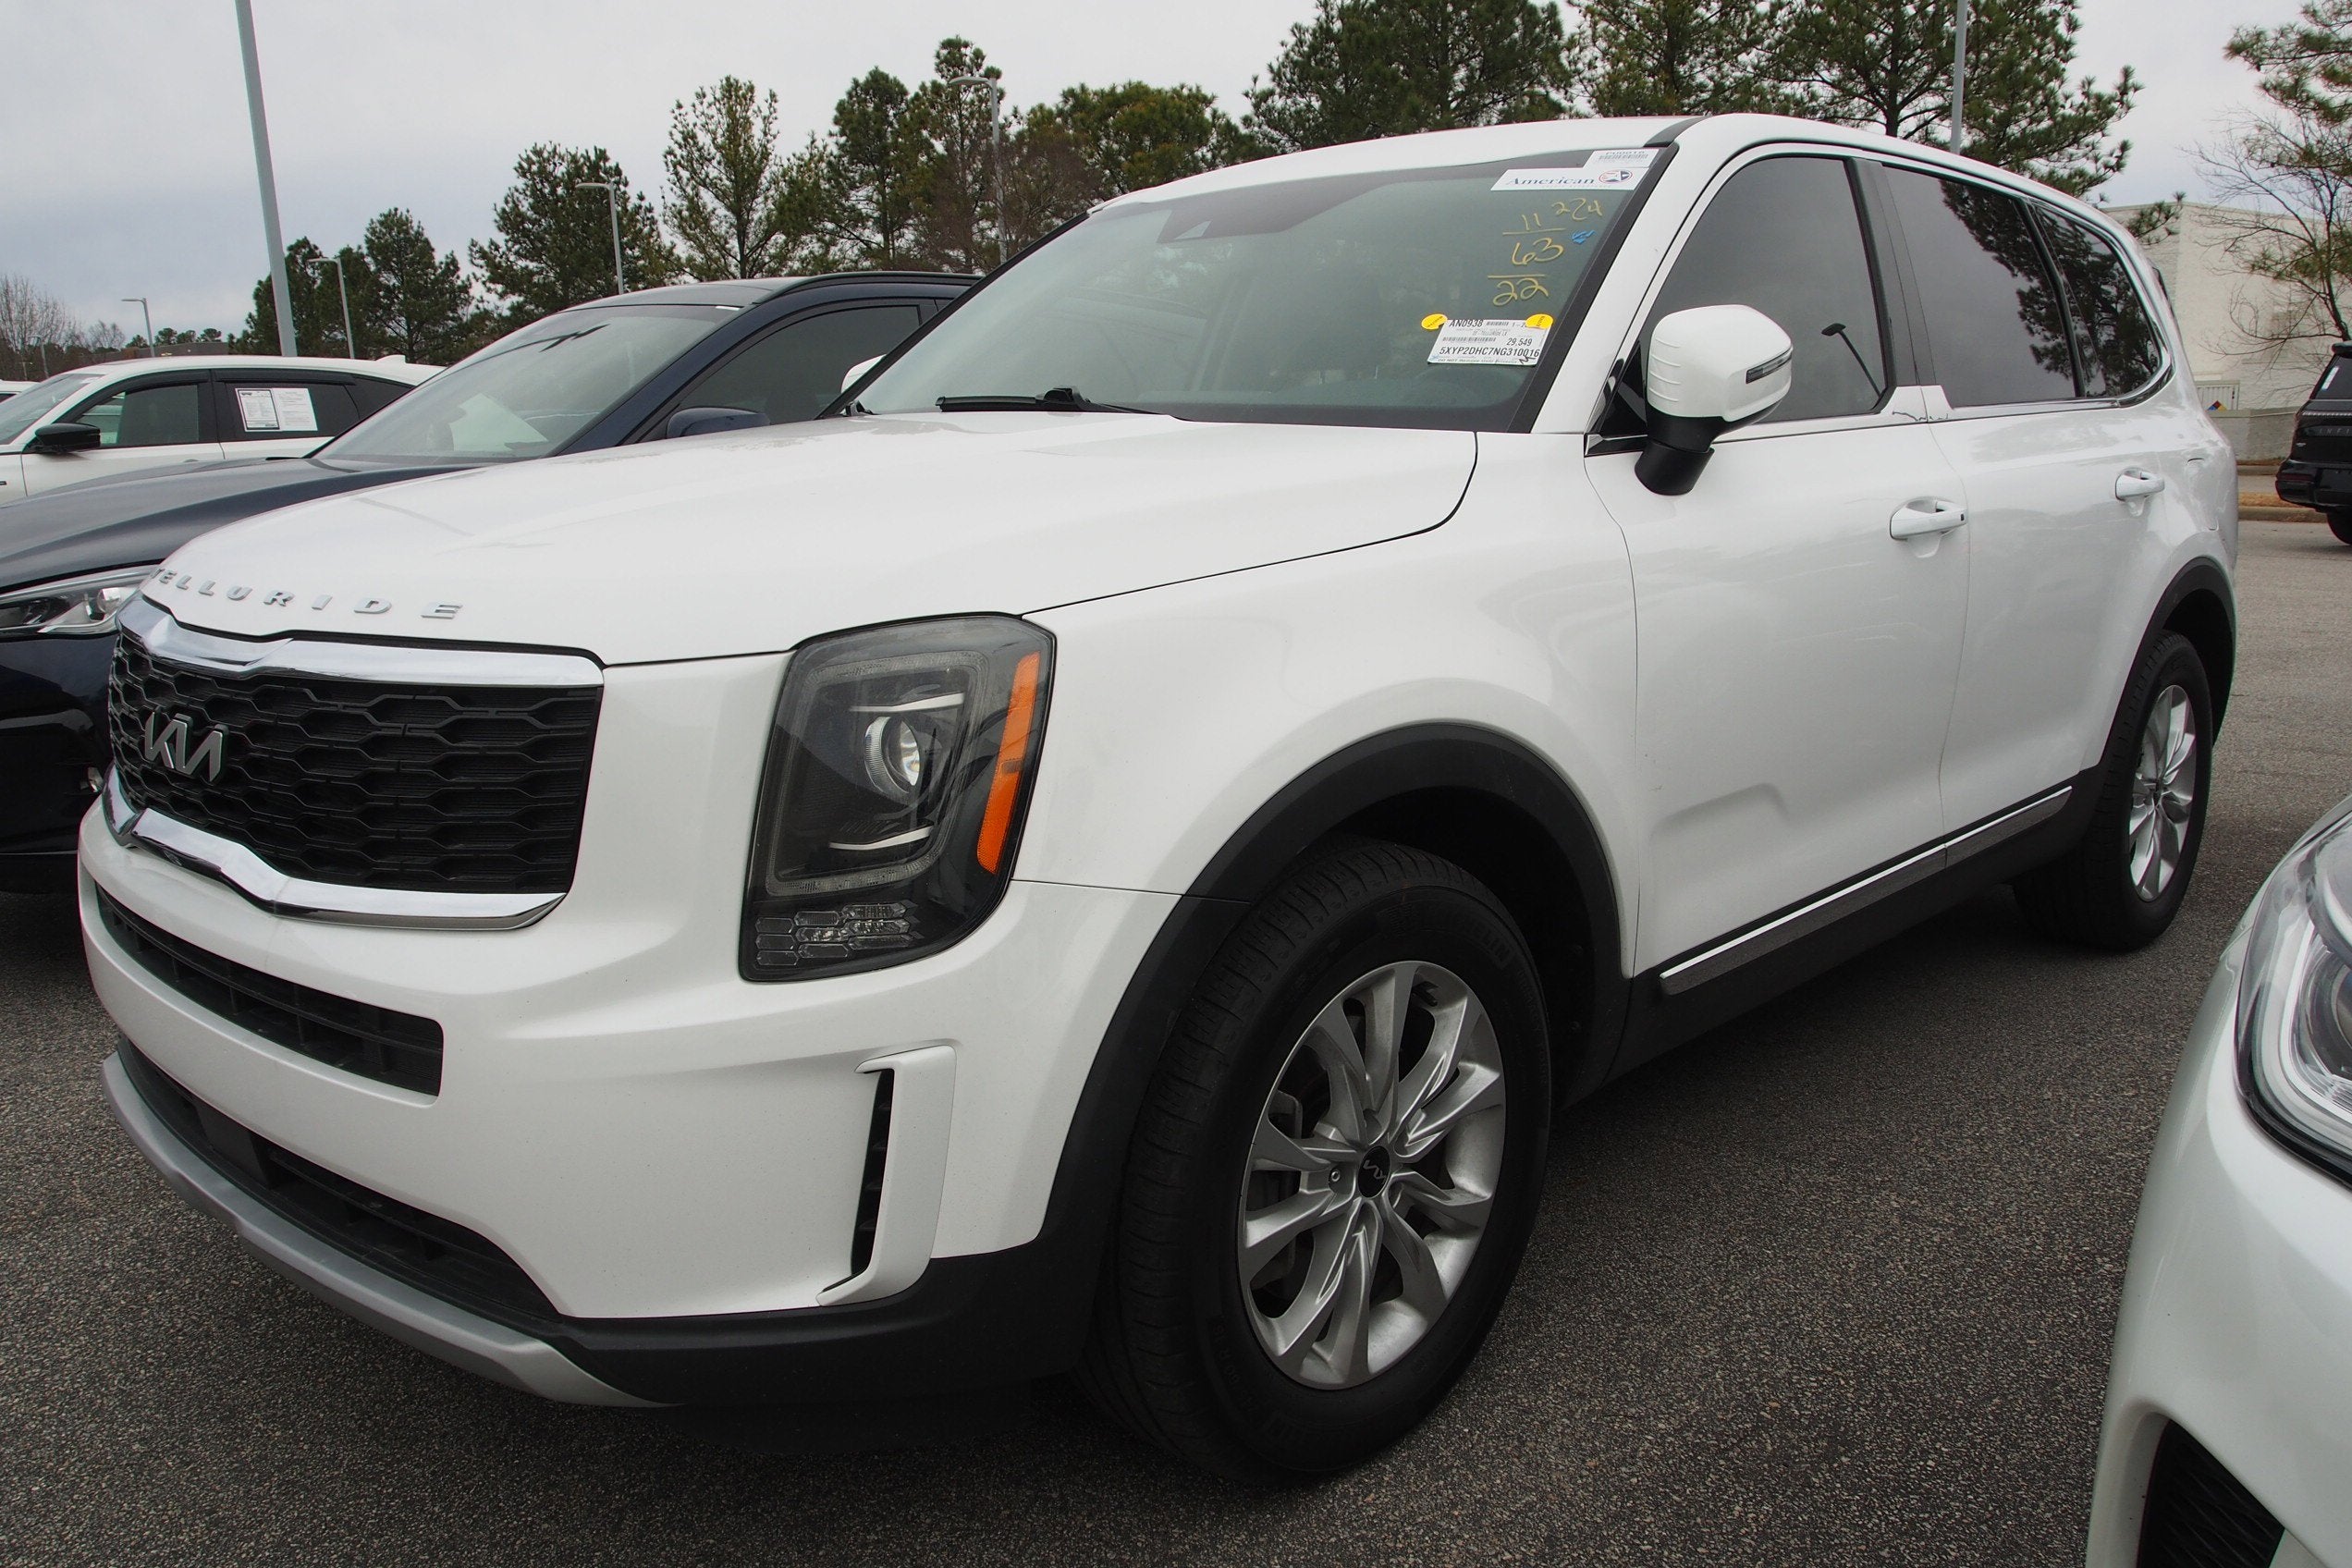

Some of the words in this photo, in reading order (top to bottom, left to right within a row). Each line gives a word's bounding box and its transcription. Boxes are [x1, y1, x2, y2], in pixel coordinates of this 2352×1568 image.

[1505, 177, 1595, 185] American
[1511, 237, 1564, 265] 63
[1448, 319, 1484, 328] AN0938
[1439, 346, 1540, 358] 5XYP2DHC7NG310016
[150, 567, 463, 620] TELLURIDE
